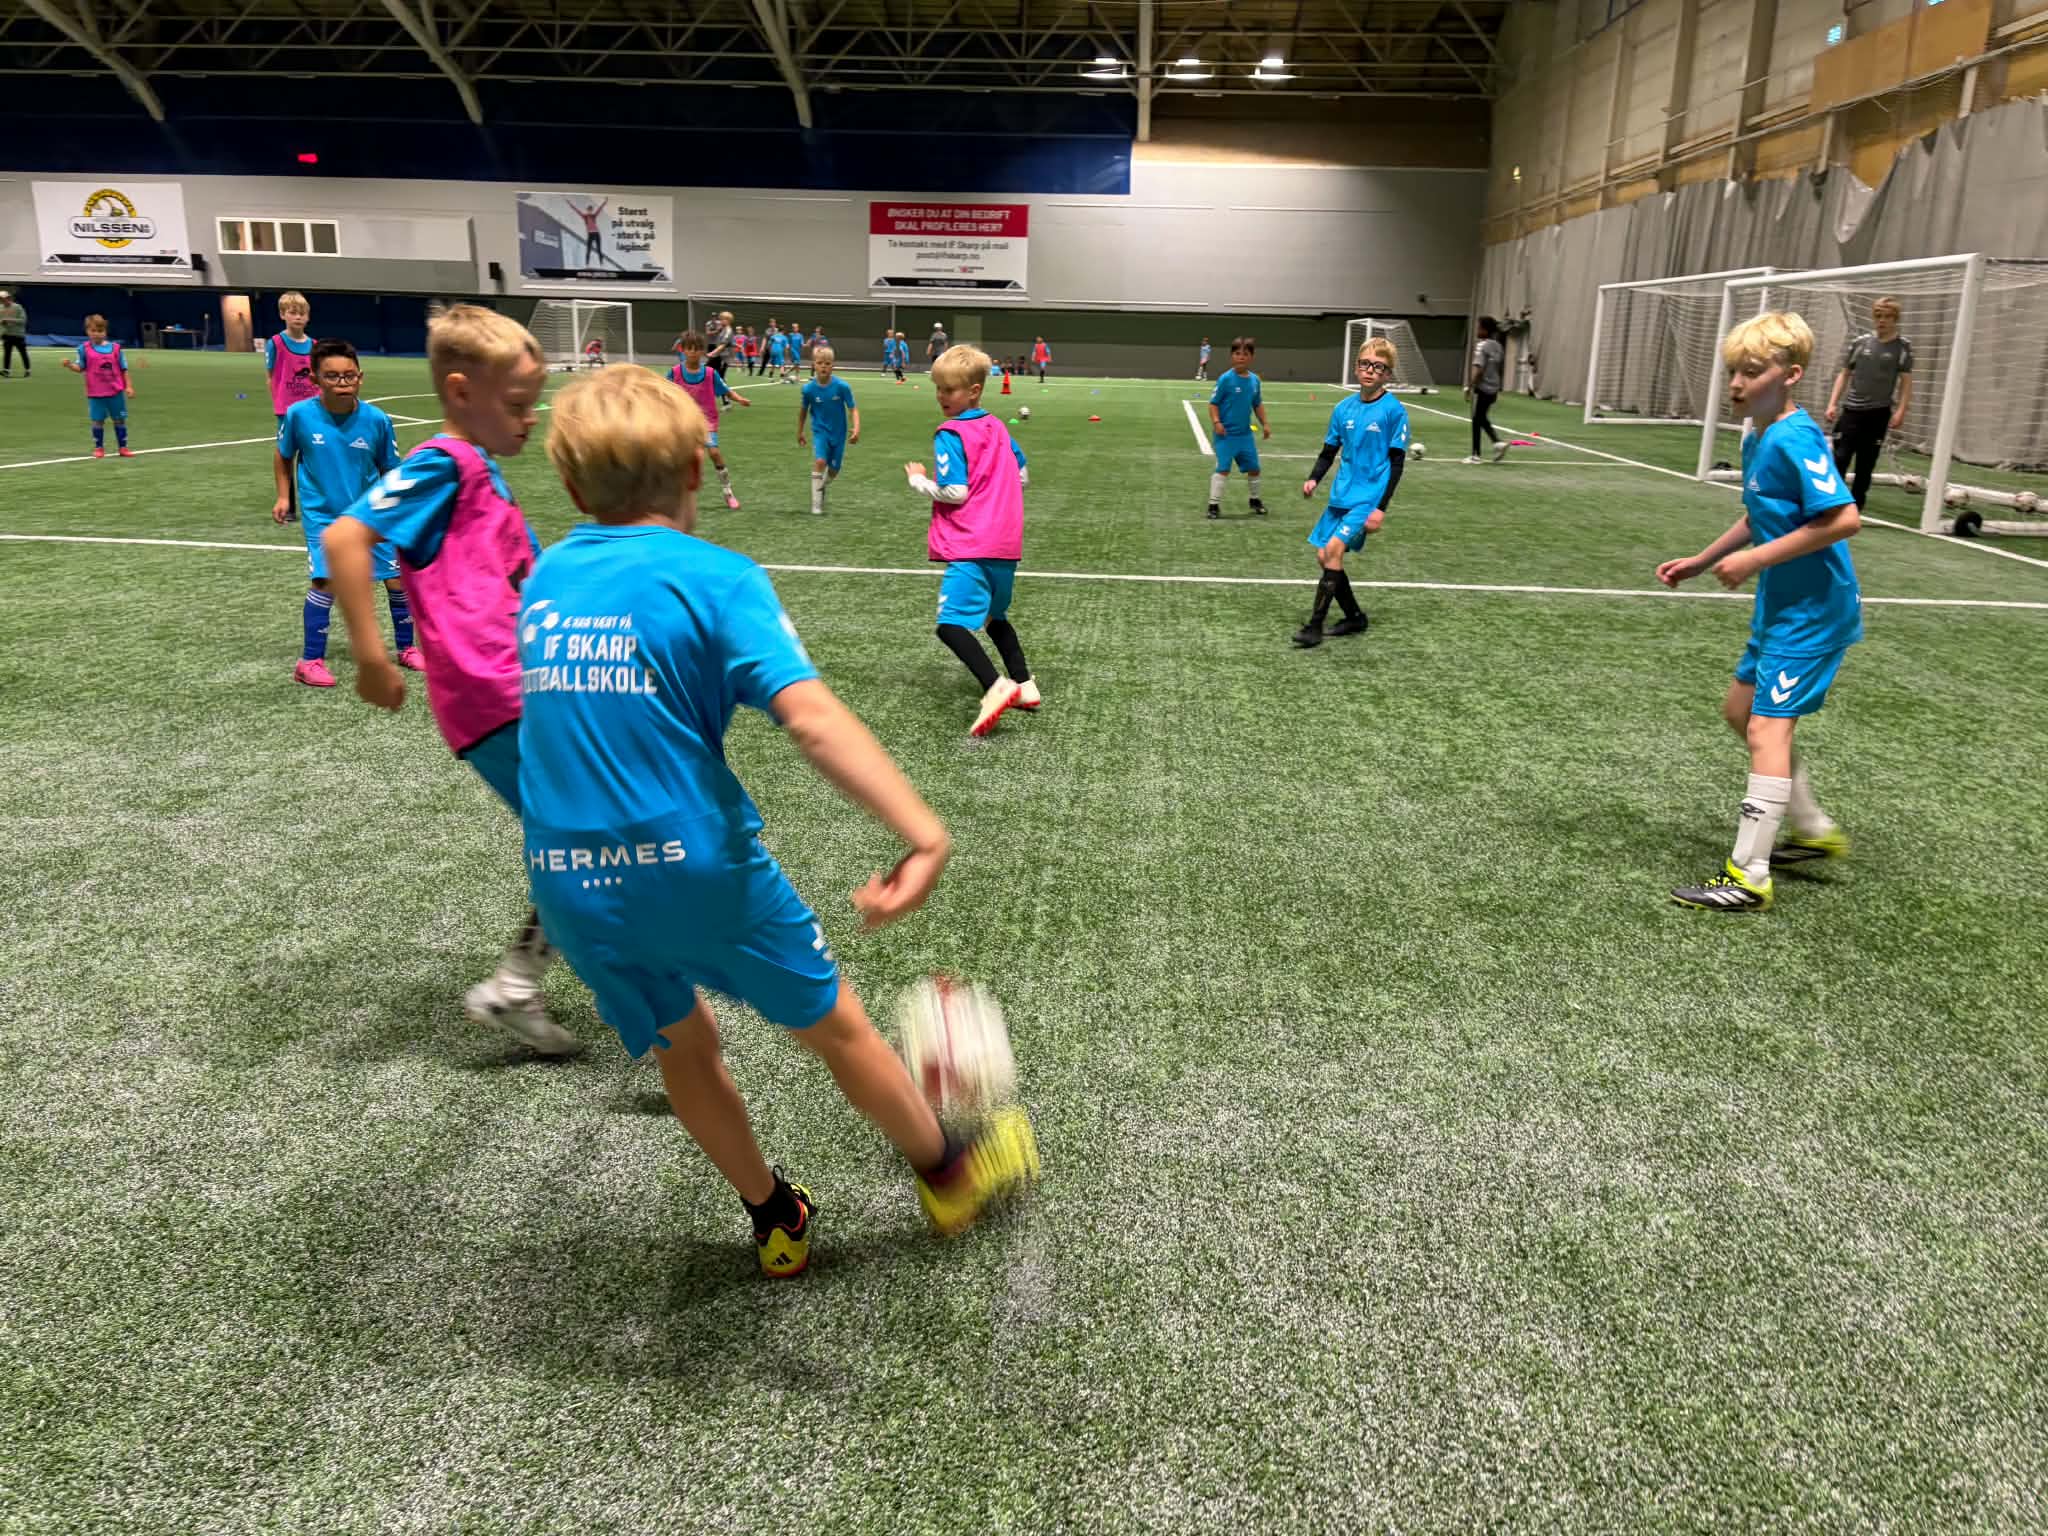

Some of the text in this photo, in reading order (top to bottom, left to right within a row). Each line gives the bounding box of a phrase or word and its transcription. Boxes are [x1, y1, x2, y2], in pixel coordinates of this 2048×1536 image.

[618, 206, 648, 216] Størst
[887, 208, 1011, 220] ØNSKER DU AT DIN BEDRIFT
[73, 223, 144, 233] NILSSEN
[611, 218, 655, 230] på utvalg
[895, 221, 920, 231] SKAL
[921, 222, 977, 232] PROFILERES
[643, 230, 656, 241] på
[888, 239, 1009, 251] Ta kontakt med IF Skarp på mail
[544, 633, 637, 662] IF SKARP
[529, 840, 686, 872] HERMES
